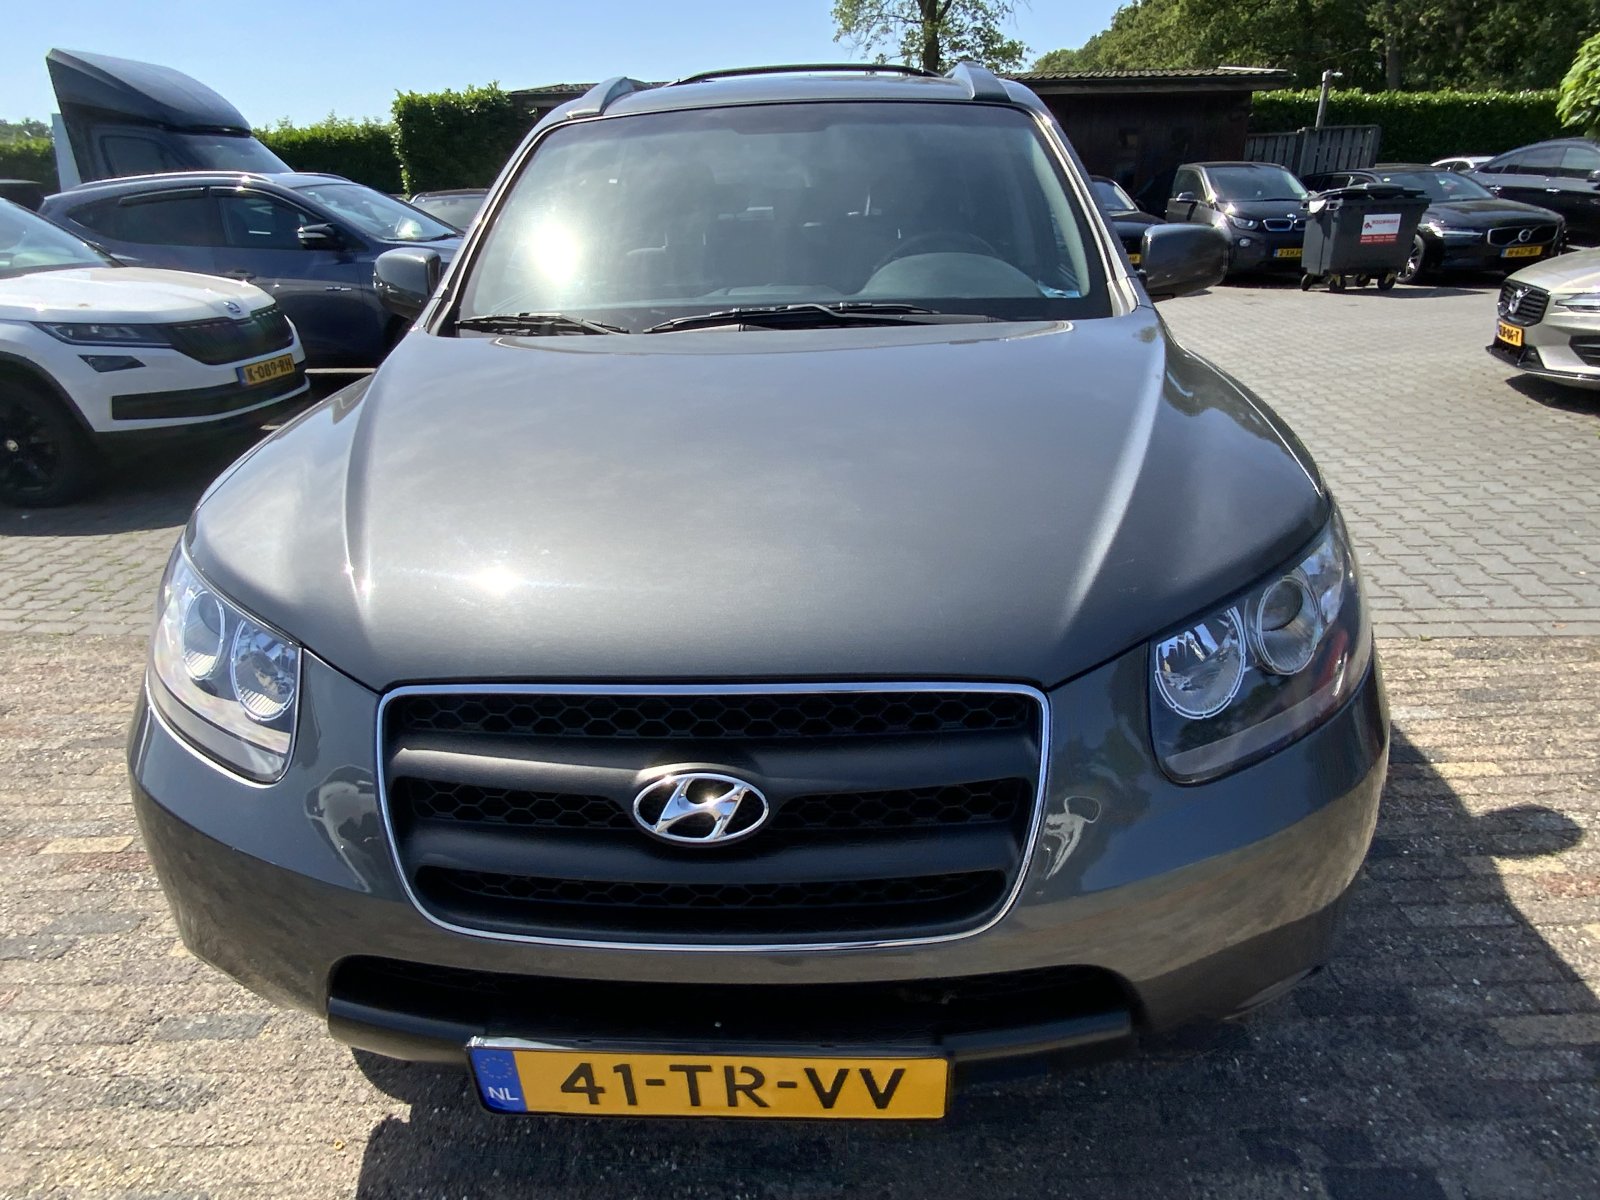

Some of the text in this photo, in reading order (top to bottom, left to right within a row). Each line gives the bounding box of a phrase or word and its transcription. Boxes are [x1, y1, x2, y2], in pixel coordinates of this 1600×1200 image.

[245, 356, 293, 381] K-089-RH
[488, 1086, 519, 1101] NL
[560, 1062, 906, 1109] 41-TR-VV
